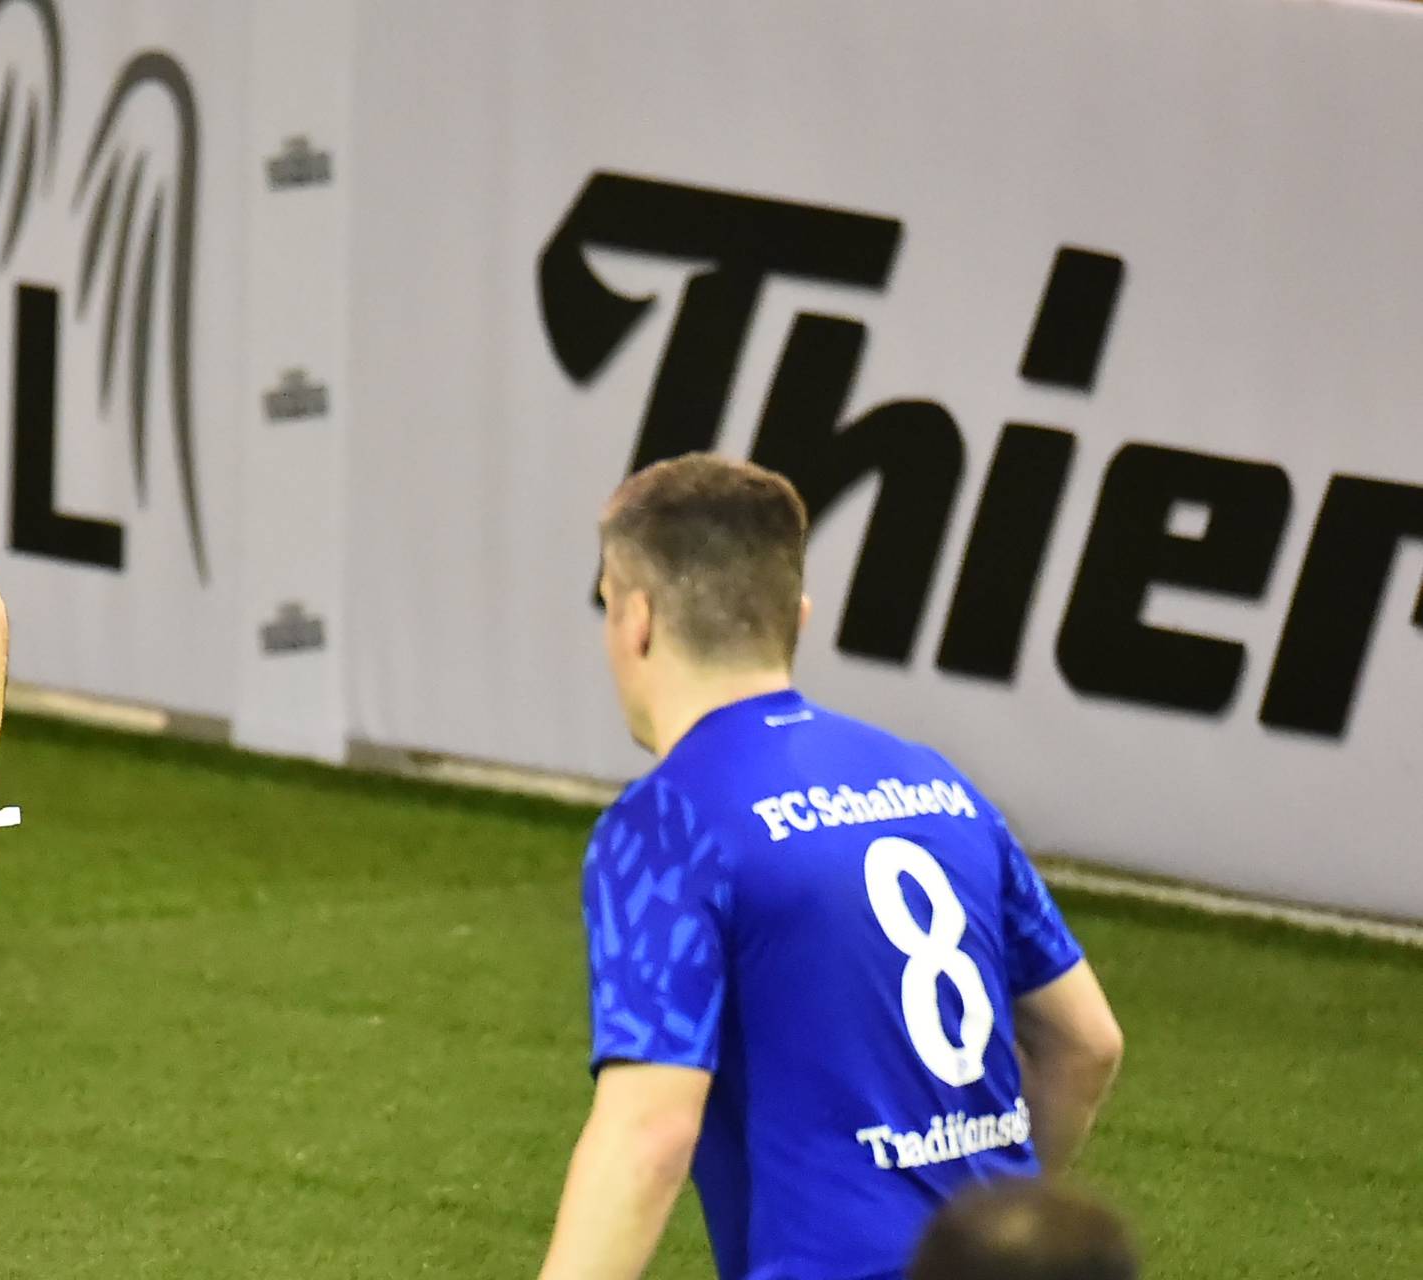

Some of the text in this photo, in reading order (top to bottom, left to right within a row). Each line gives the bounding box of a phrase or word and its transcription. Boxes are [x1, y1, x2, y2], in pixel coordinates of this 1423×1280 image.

[751, 790, 818, 842] FC
[807, 777, 942, 828] Schalke
[864, 836, 994, 1087] 8
